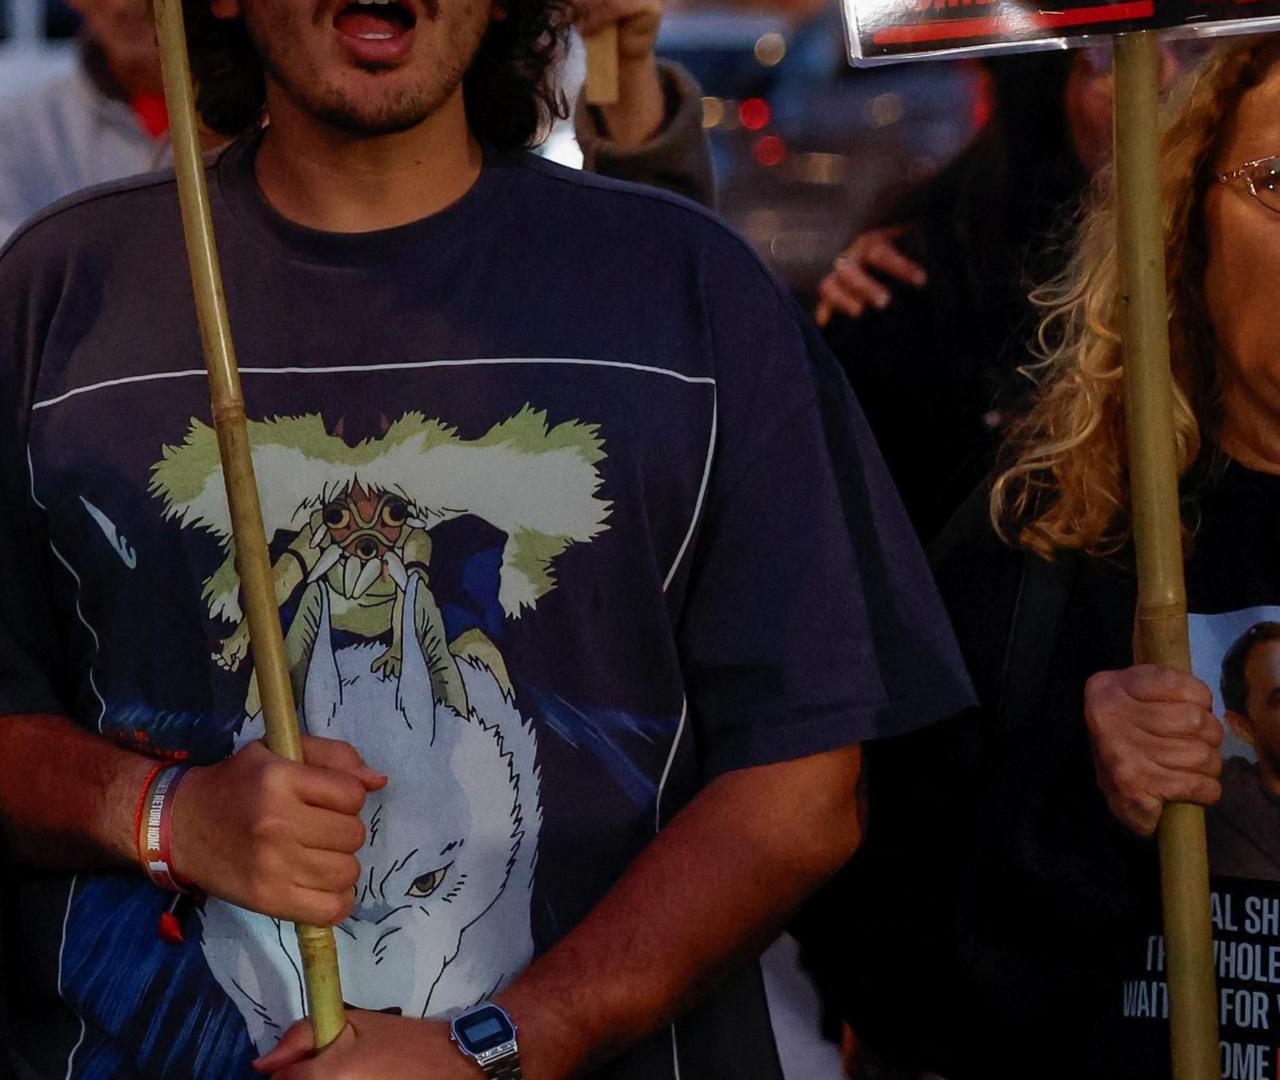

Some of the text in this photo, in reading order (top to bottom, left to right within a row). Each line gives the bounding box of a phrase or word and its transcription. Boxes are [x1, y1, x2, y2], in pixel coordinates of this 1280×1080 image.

[147, 827, 160, 851] HOME
[1210, 892, 1238, 931] AL
[1213, 940, 1280, 984] HOLE
[1220, 988, 1270, 1029] FOR
[1220, 1040, 1271, 1080] OME
